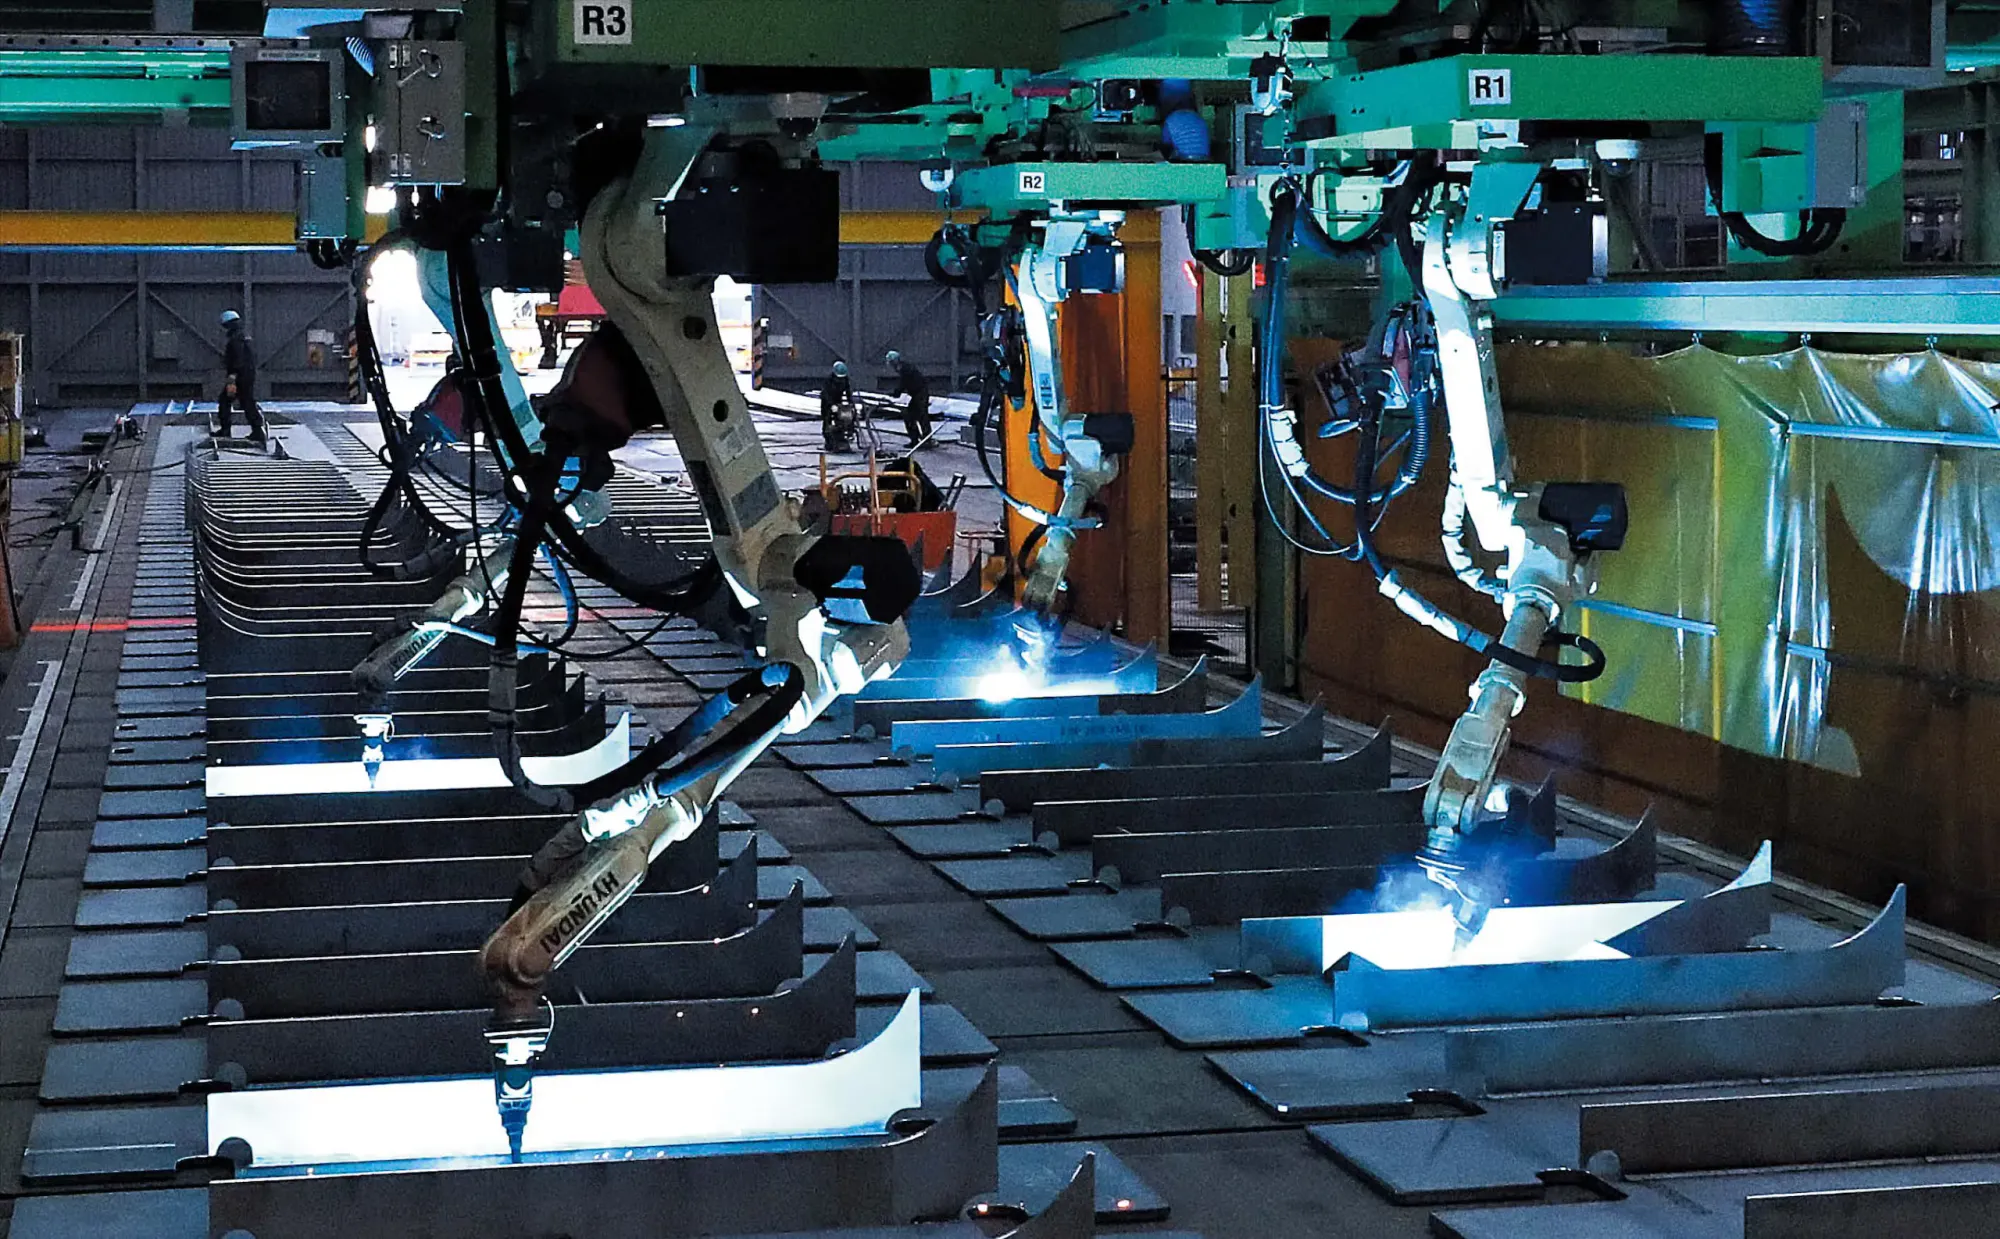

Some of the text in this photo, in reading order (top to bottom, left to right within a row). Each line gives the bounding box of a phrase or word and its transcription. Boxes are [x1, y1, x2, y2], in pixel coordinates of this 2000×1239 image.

[582, 5, 626, 36] R3
[1475, 75, 1504, 98] R1
[1023, 175, 1042, 189] R2
[540, 871, 619, 953] HYUNDAI
